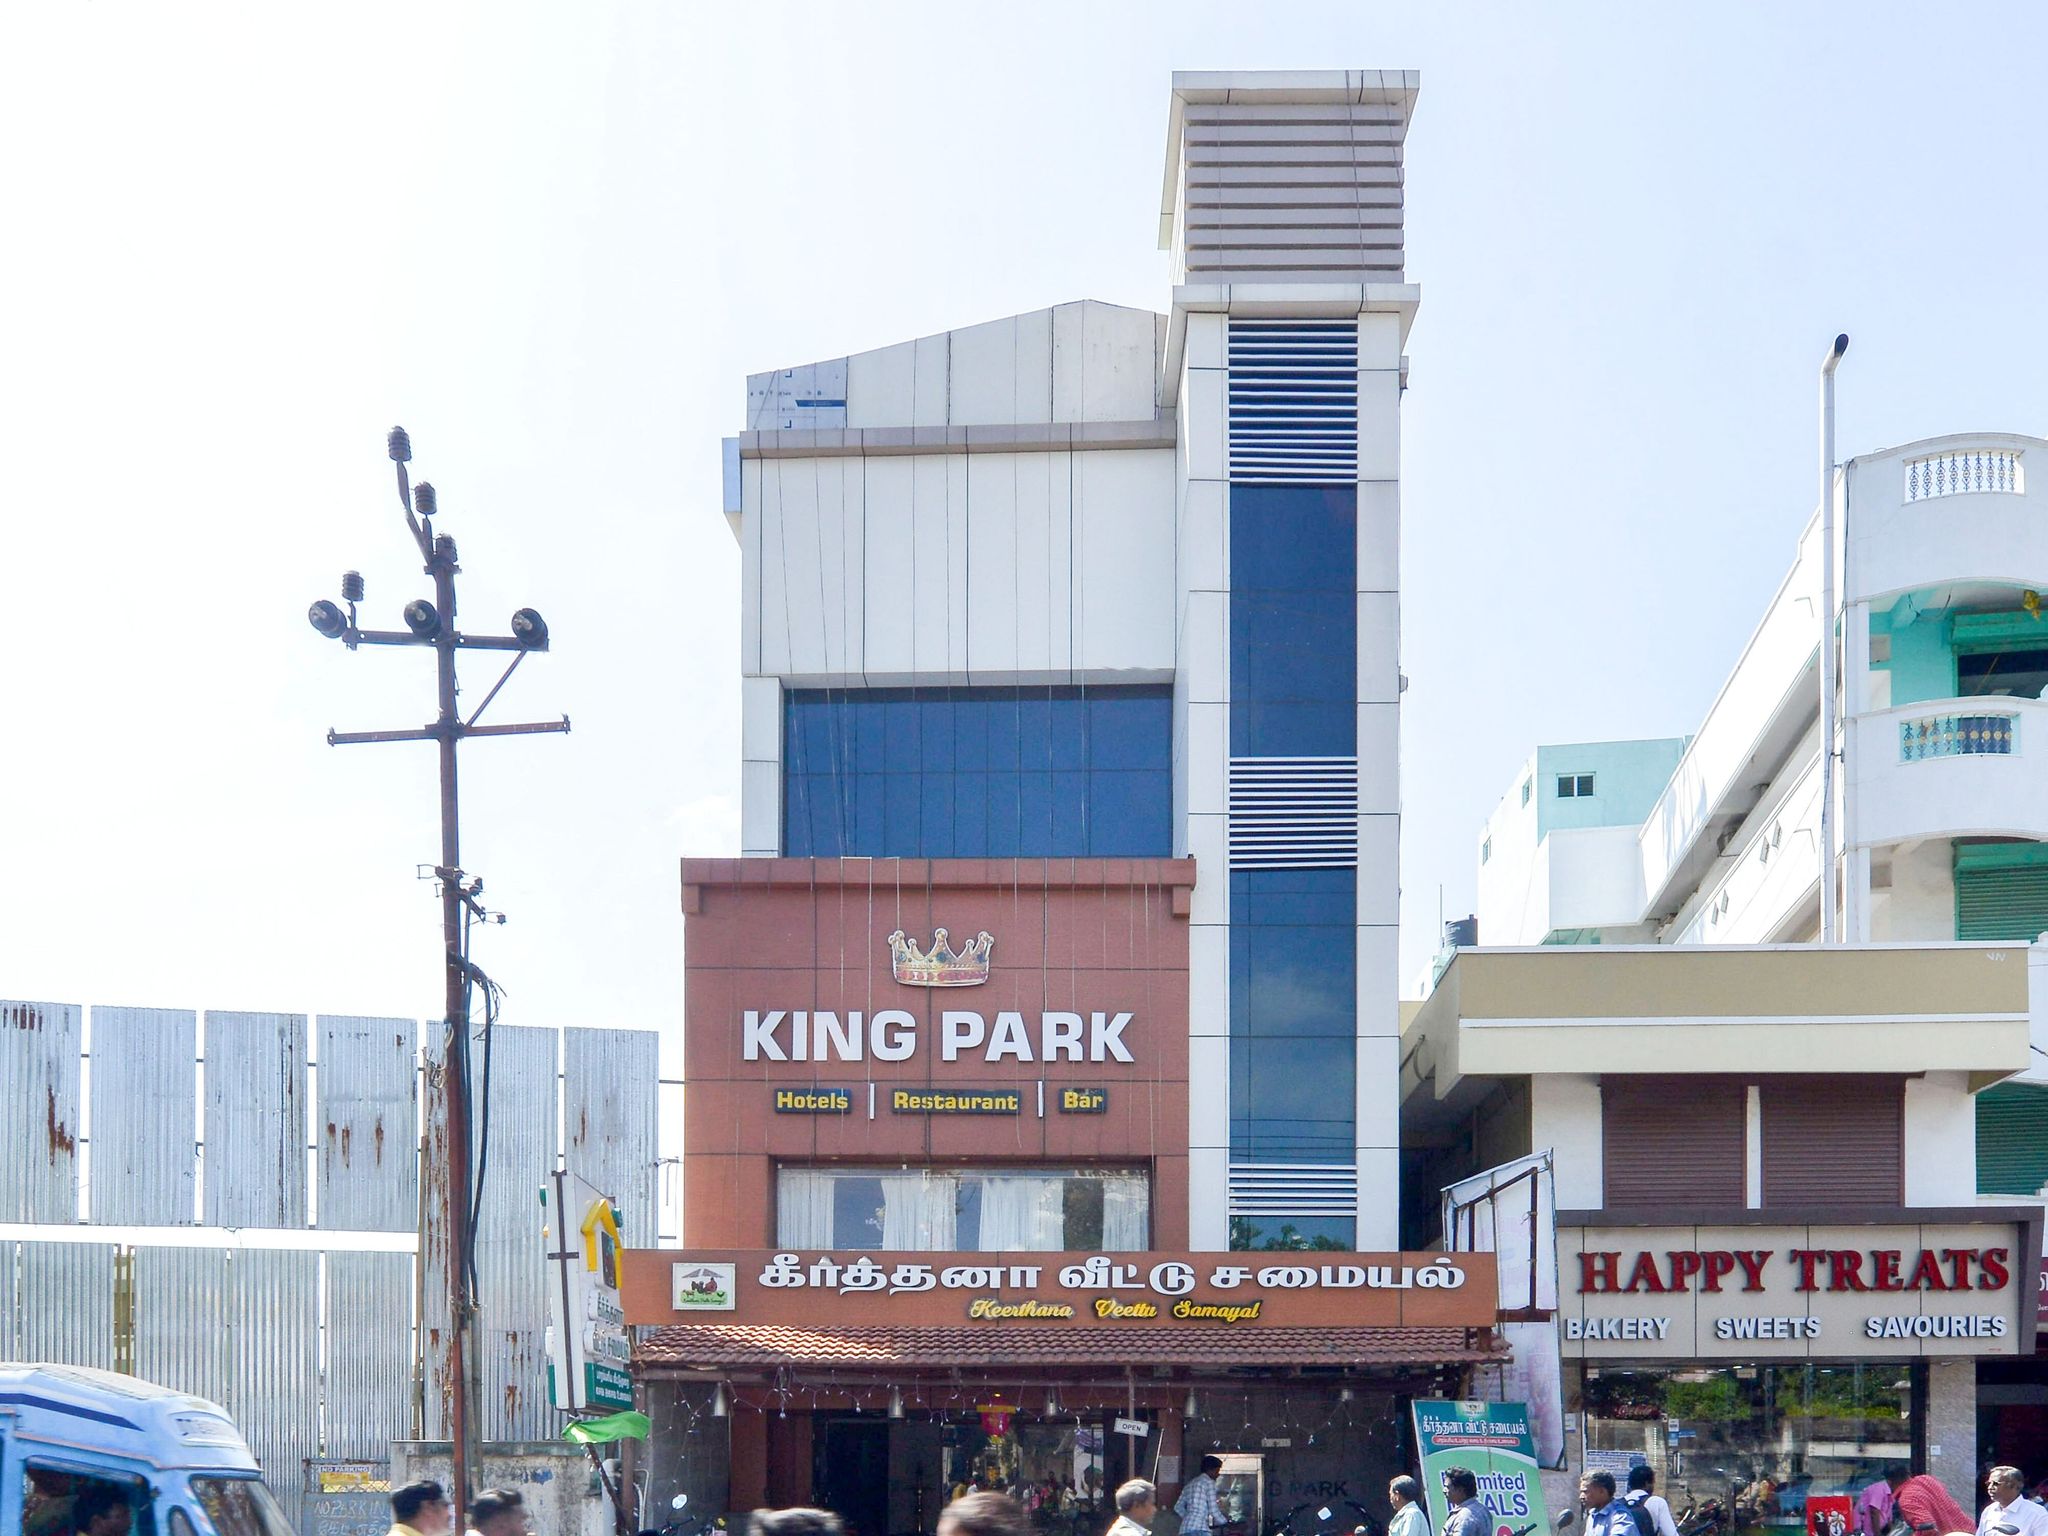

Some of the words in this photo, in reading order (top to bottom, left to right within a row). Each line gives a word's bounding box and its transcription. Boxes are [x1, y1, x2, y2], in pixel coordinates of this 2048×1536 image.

[742, 1010, 916, 1062] KING
[941, 1010, 1135, 1063] PARK
[776, 1090, 849, 1110] Hotels
[893, 1090, 1019, 1111] Restaurant
[1062, 1090, 1104, 1109] Bar
[758, 1253, 1042, 1296] கீர்த்தனா
[1058, 1256, 1196, 1296] வீட்டு
[1209, 1257, 1466, 1289] சமையல்
[1576, 1250, 1774, 1294] HAPPY
[1789, 1248, 2010, 1293] TREATS
[968, 1298, 1074, 1320] Keerthana
[1094, 1298, 1158, 1318] Veettu
[1172, 1299, 1261, 1324] Samayal
[1565, 1317, 1672, 1340] BAKERY
[1715, 1316, 1823, 1339] SWEETS
[1864, 1314, 2009, 1339] SAVOURIES
[1122, 1423, 1142, 1432] OPEN
[1447, 1493, 1529, 1517] ALS
